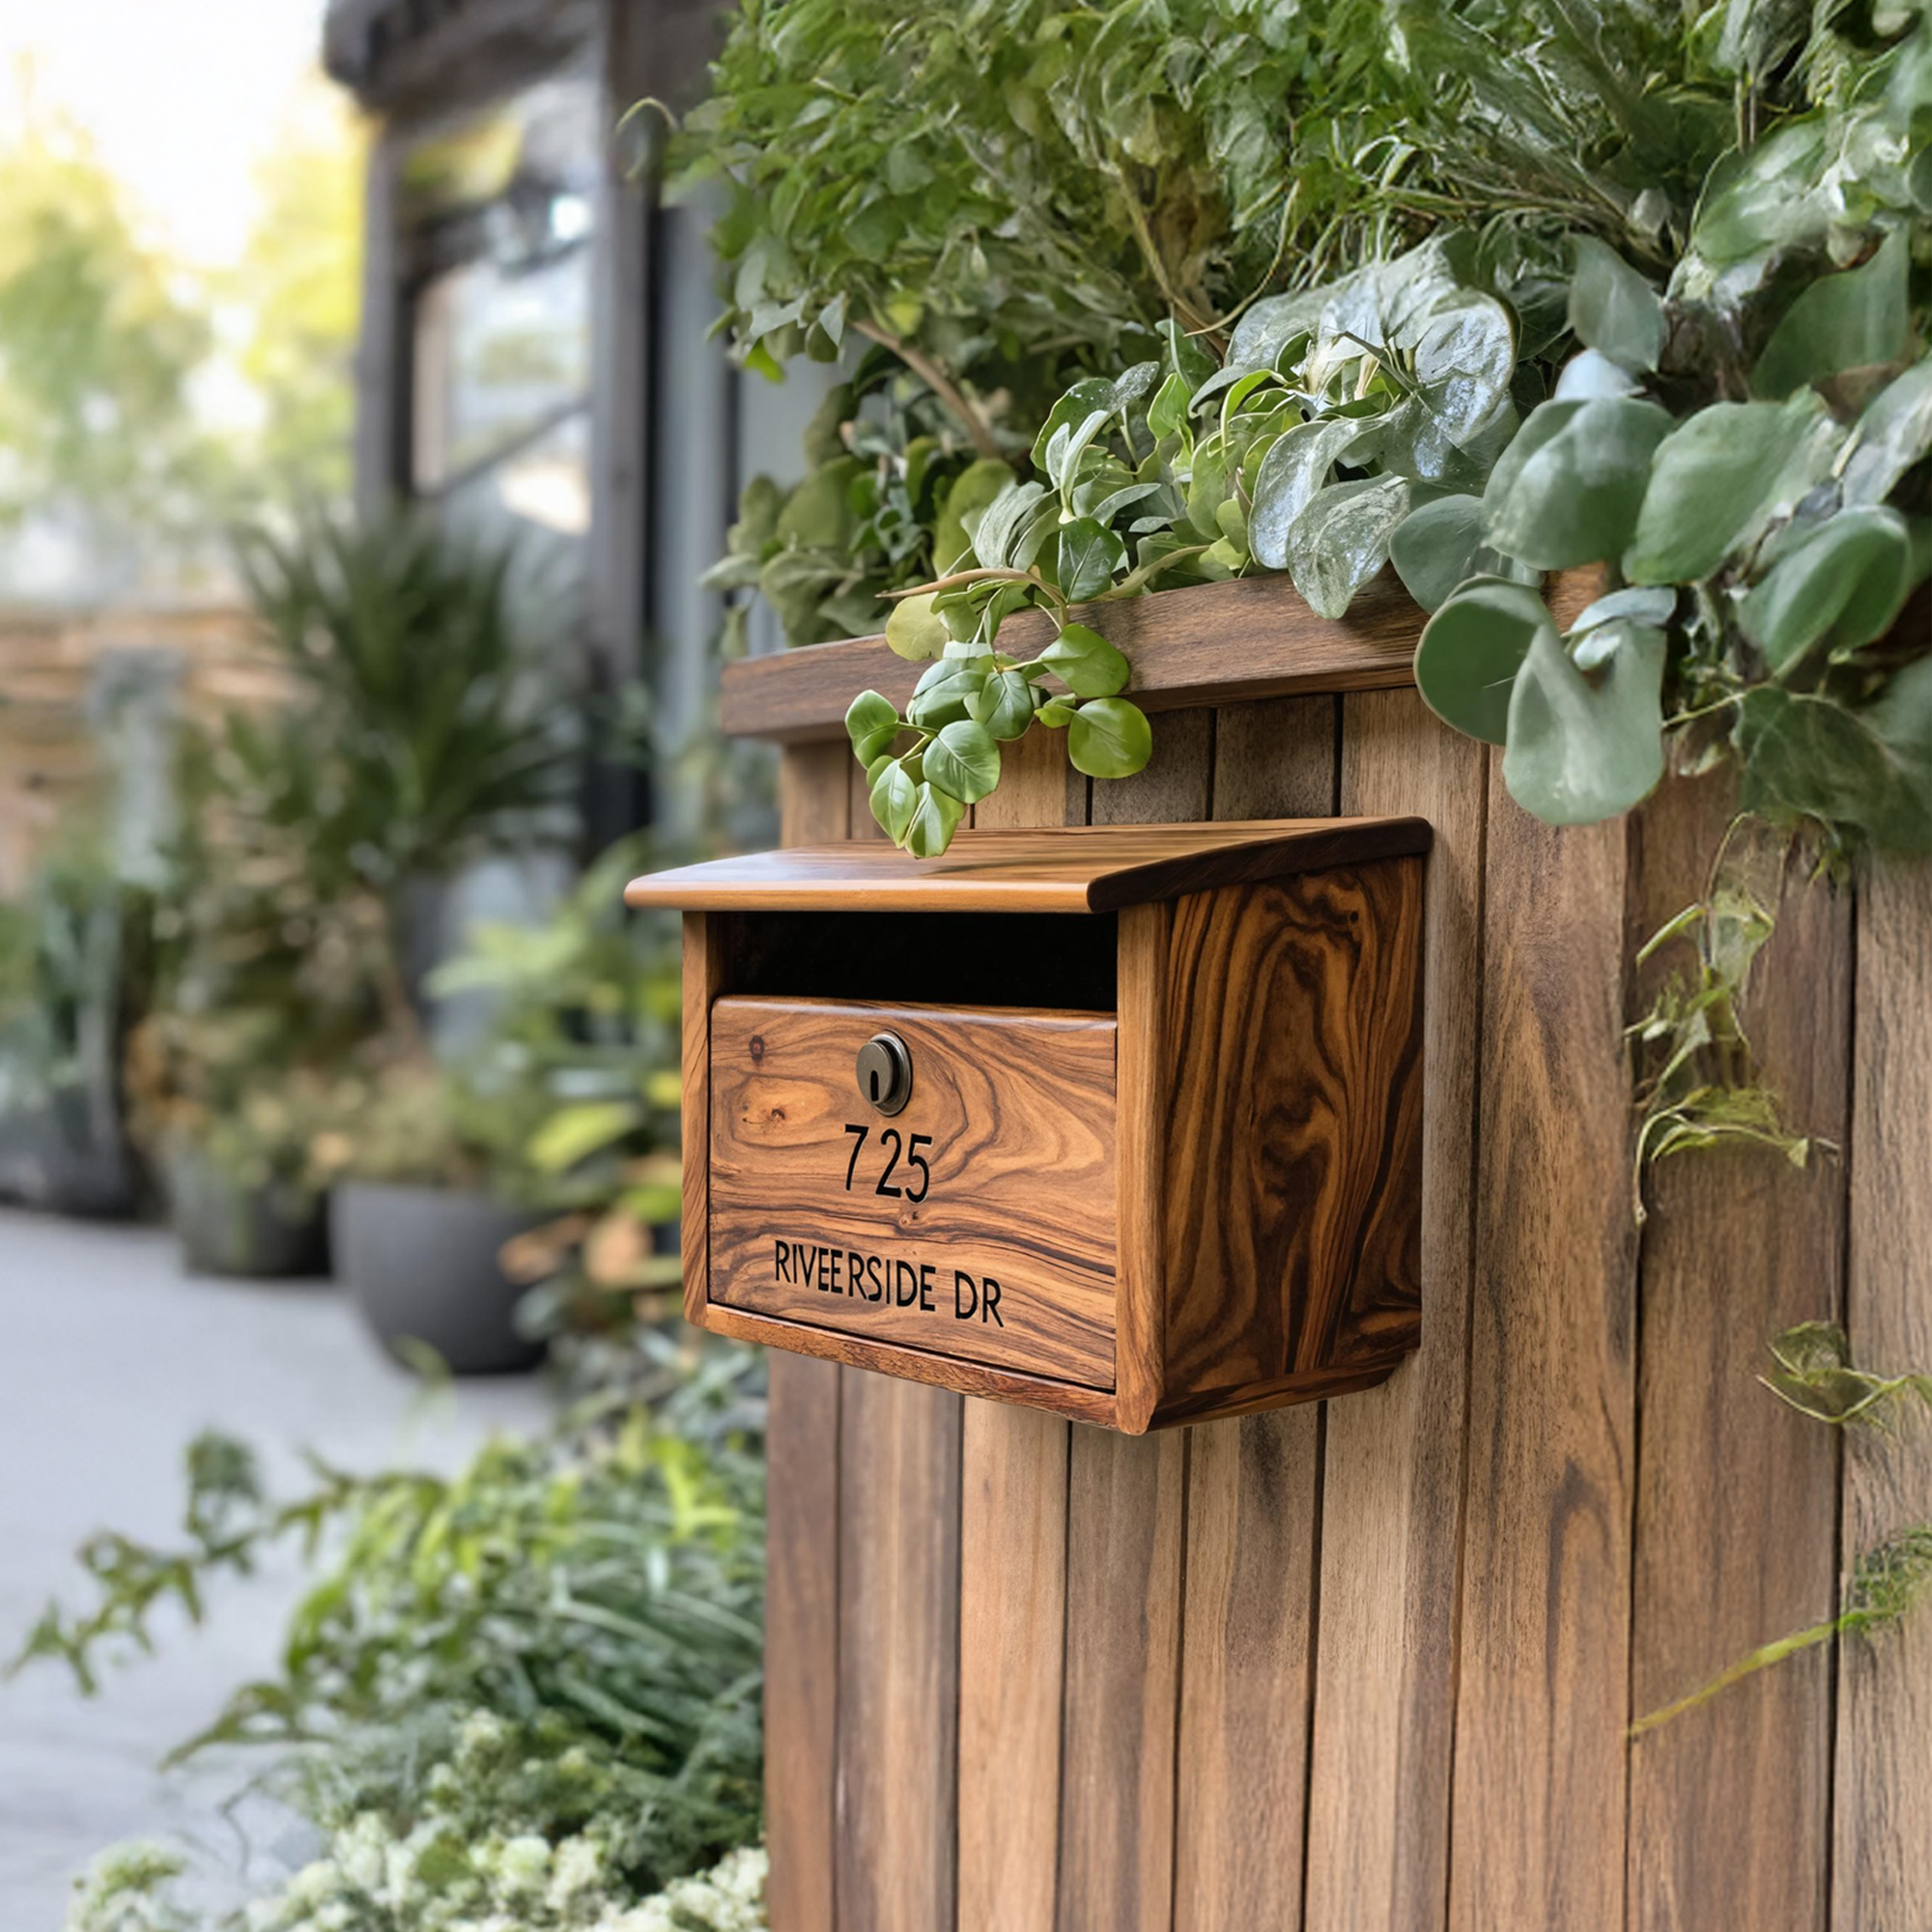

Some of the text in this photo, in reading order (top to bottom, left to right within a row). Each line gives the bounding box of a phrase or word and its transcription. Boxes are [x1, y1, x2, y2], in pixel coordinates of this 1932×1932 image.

[844, 1123, 932, 1203] 725
[775, 1240, 1004, 1328] RIVEERSIDE DR
